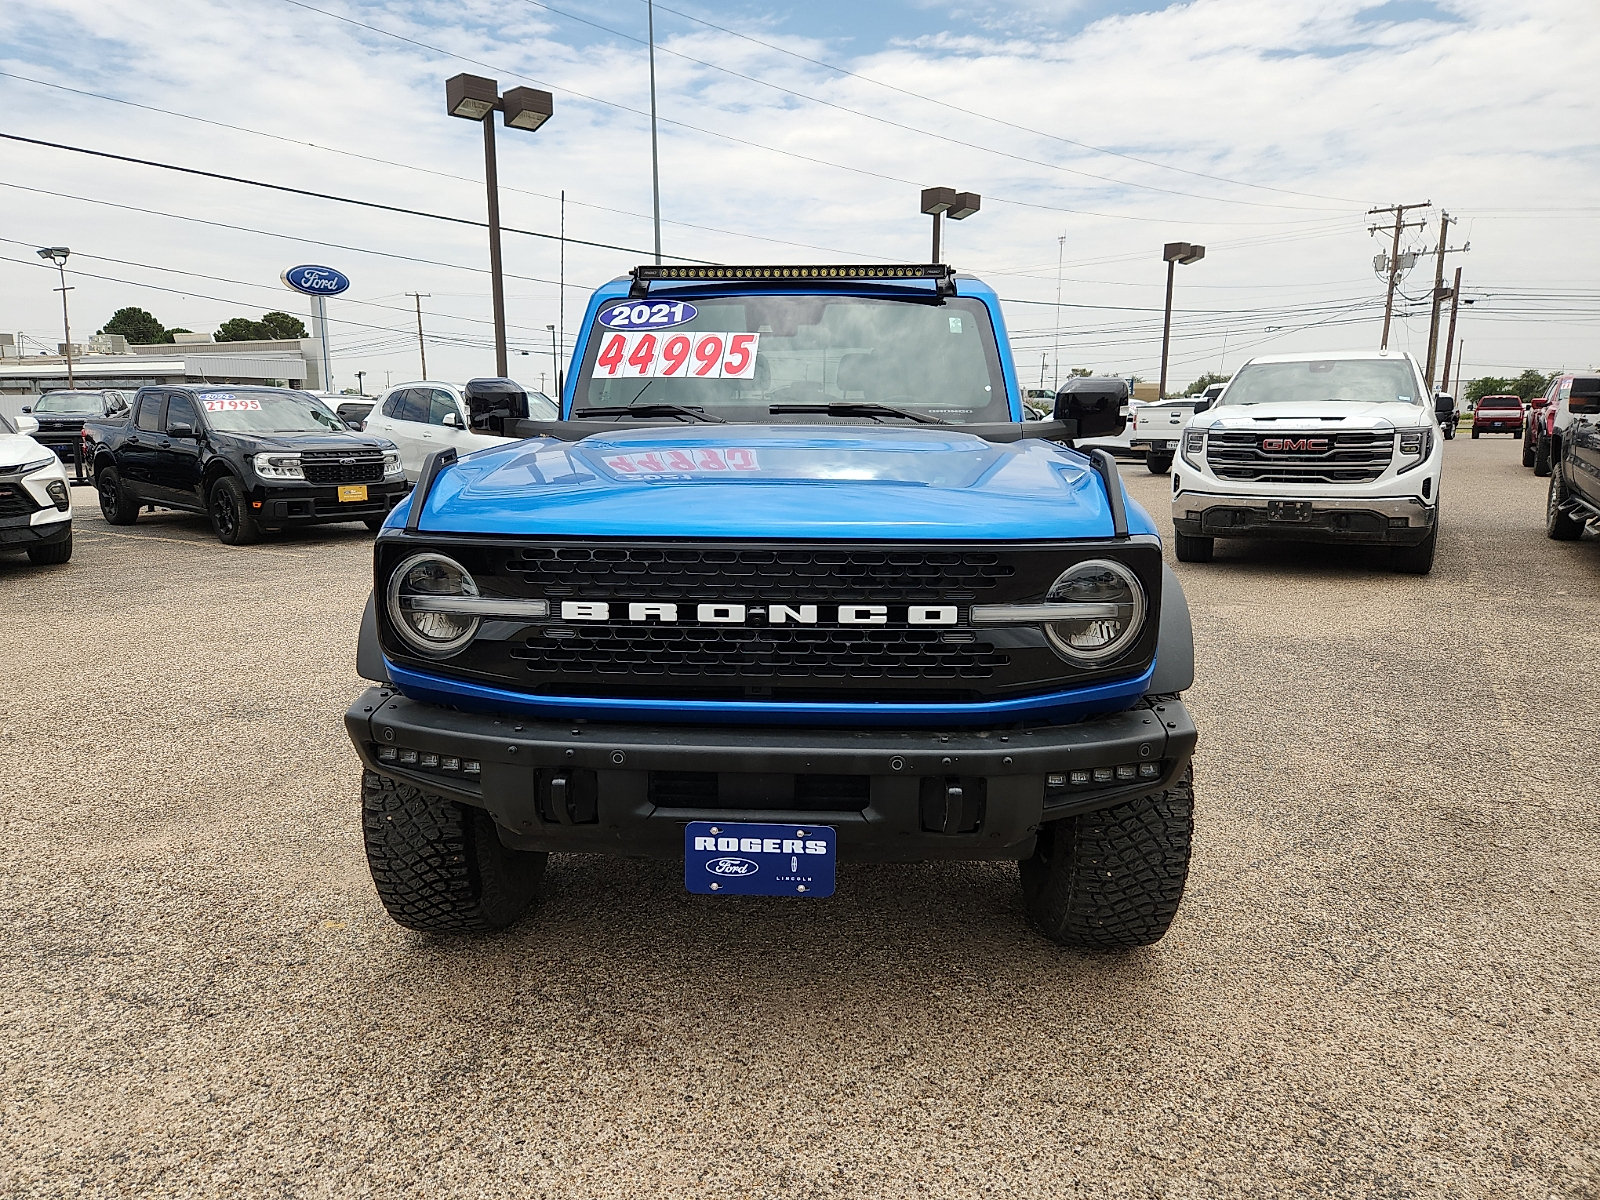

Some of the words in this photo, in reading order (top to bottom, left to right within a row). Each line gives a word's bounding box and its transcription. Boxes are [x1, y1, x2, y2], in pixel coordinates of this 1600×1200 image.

[301, 269, 339, 290] Ford
[609, 303, 685, 326] 2021
[598, 333, 757, 376] 44995
[206, 400, 259, 411] 27995
[1263, 439, 1328, 450] GMC
[561, 601, 958, 624] BRONCO
[694, 836, 827, 855] ROGERS
[715, 859, 749, 874] Ford
